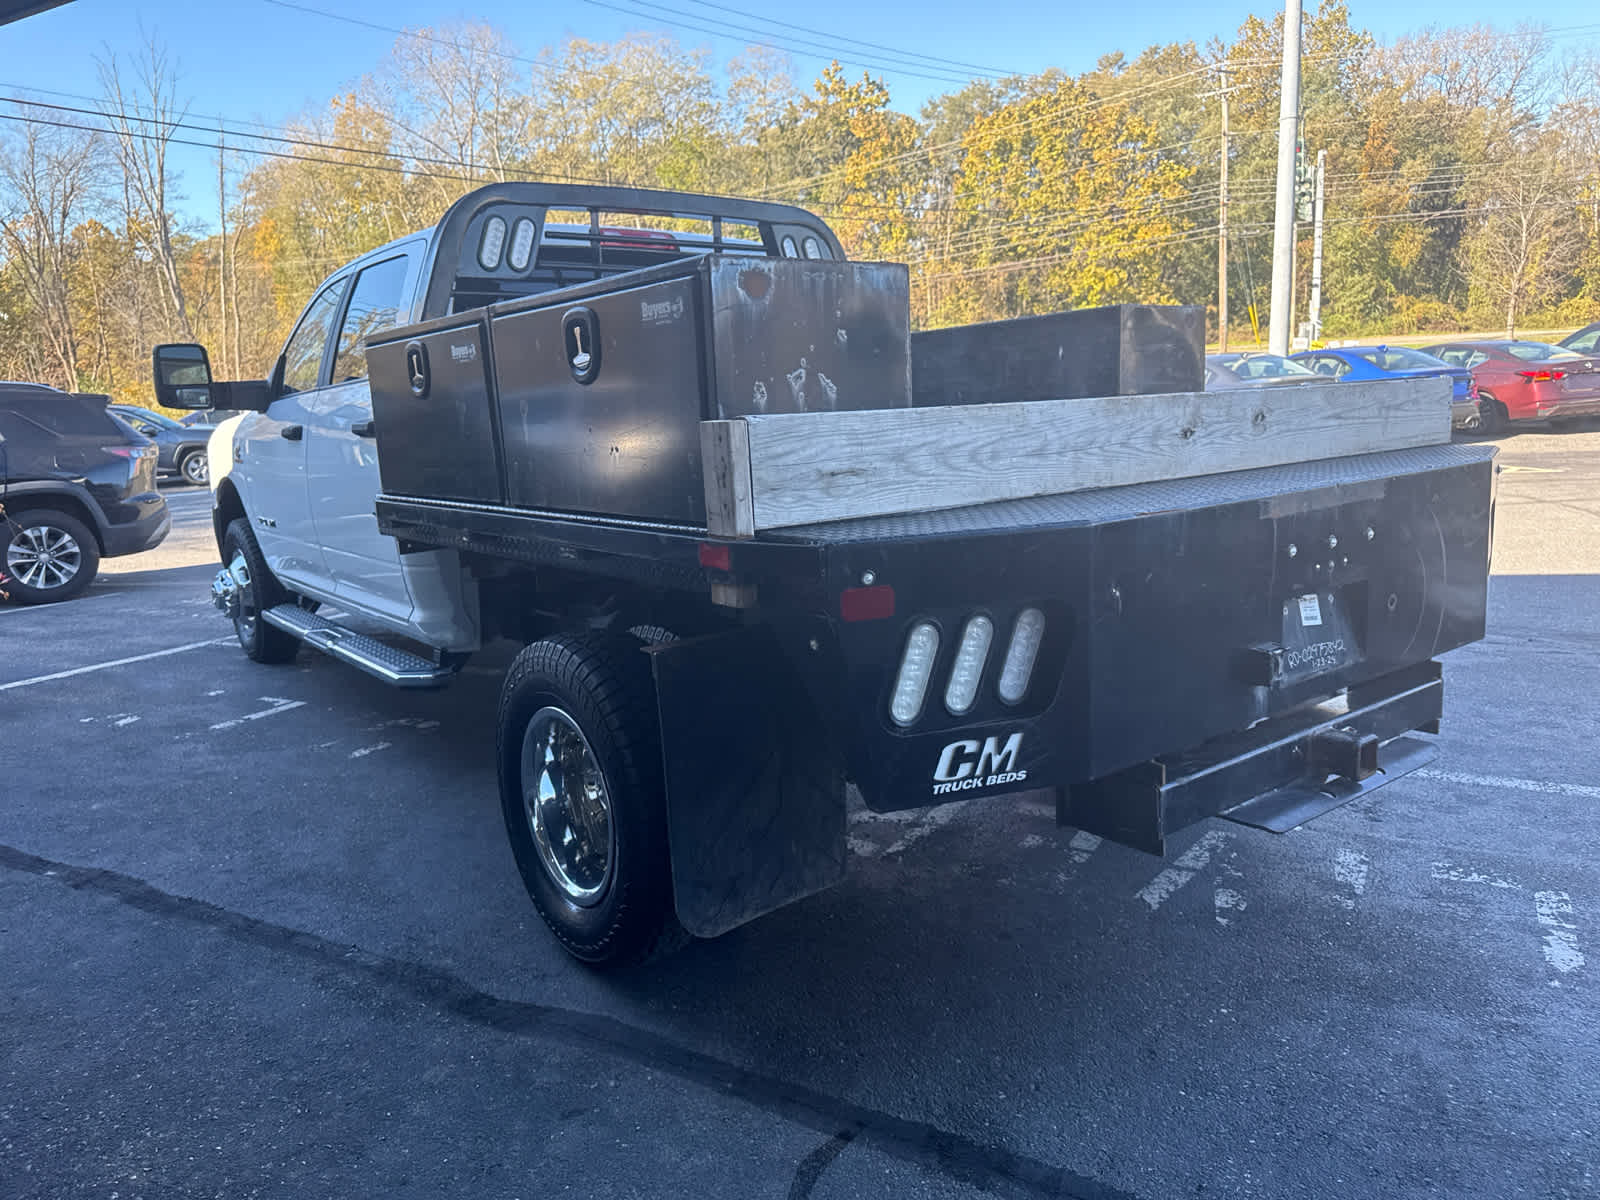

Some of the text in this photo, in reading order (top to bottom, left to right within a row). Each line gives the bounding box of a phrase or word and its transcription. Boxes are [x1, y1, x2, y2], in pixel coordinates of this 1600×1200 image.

[933, 732, 1024, 781] CM
[932, 770, 1027, 795] TRUCK BEDS
